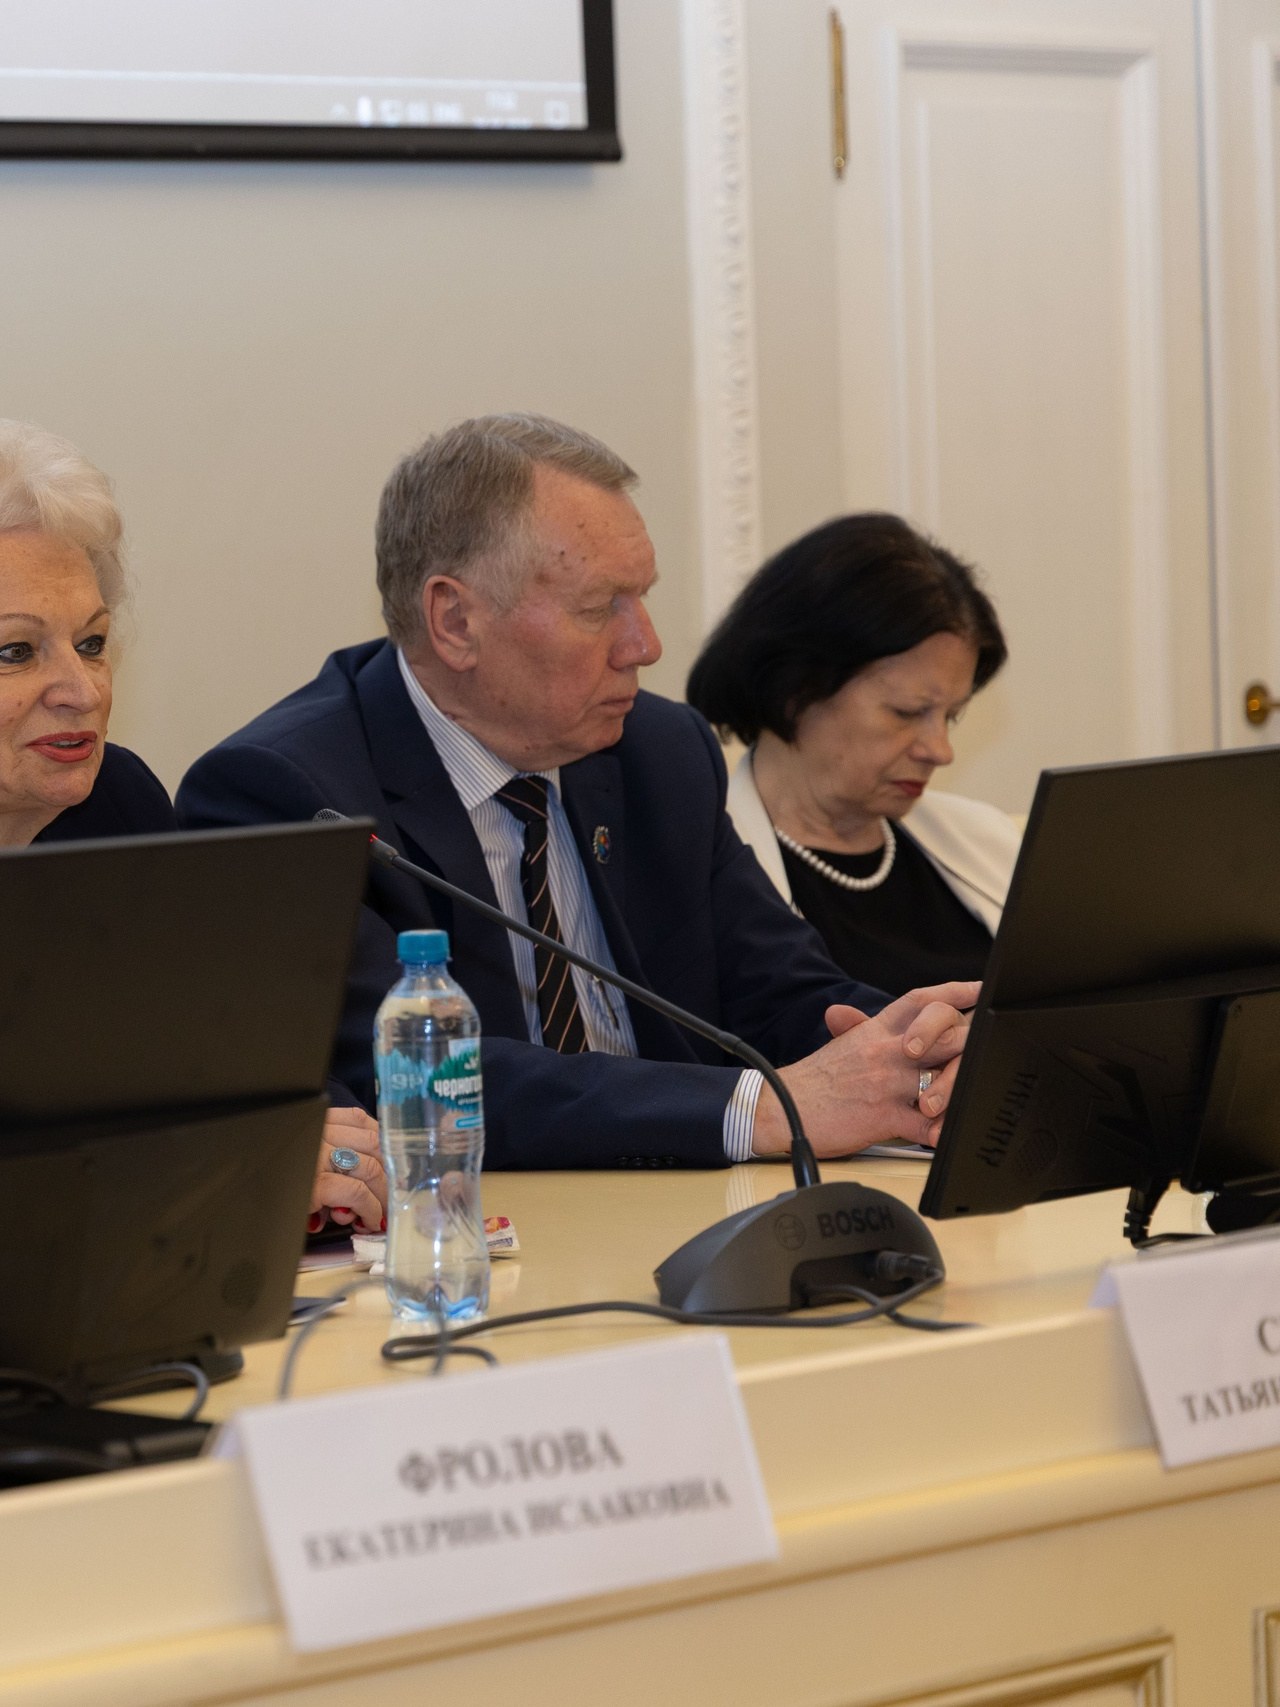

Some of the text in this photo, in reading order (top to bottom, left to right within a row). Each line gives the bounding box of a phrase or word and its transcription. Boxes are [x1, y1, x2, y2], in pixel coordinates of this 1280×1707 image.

[818, 1205, 894, 1236] BOSCH
[397, 1427, 624, 1494] ФРОЛОВА
[303, 1506, 521, 1570] ЕКАТЕРИНА
